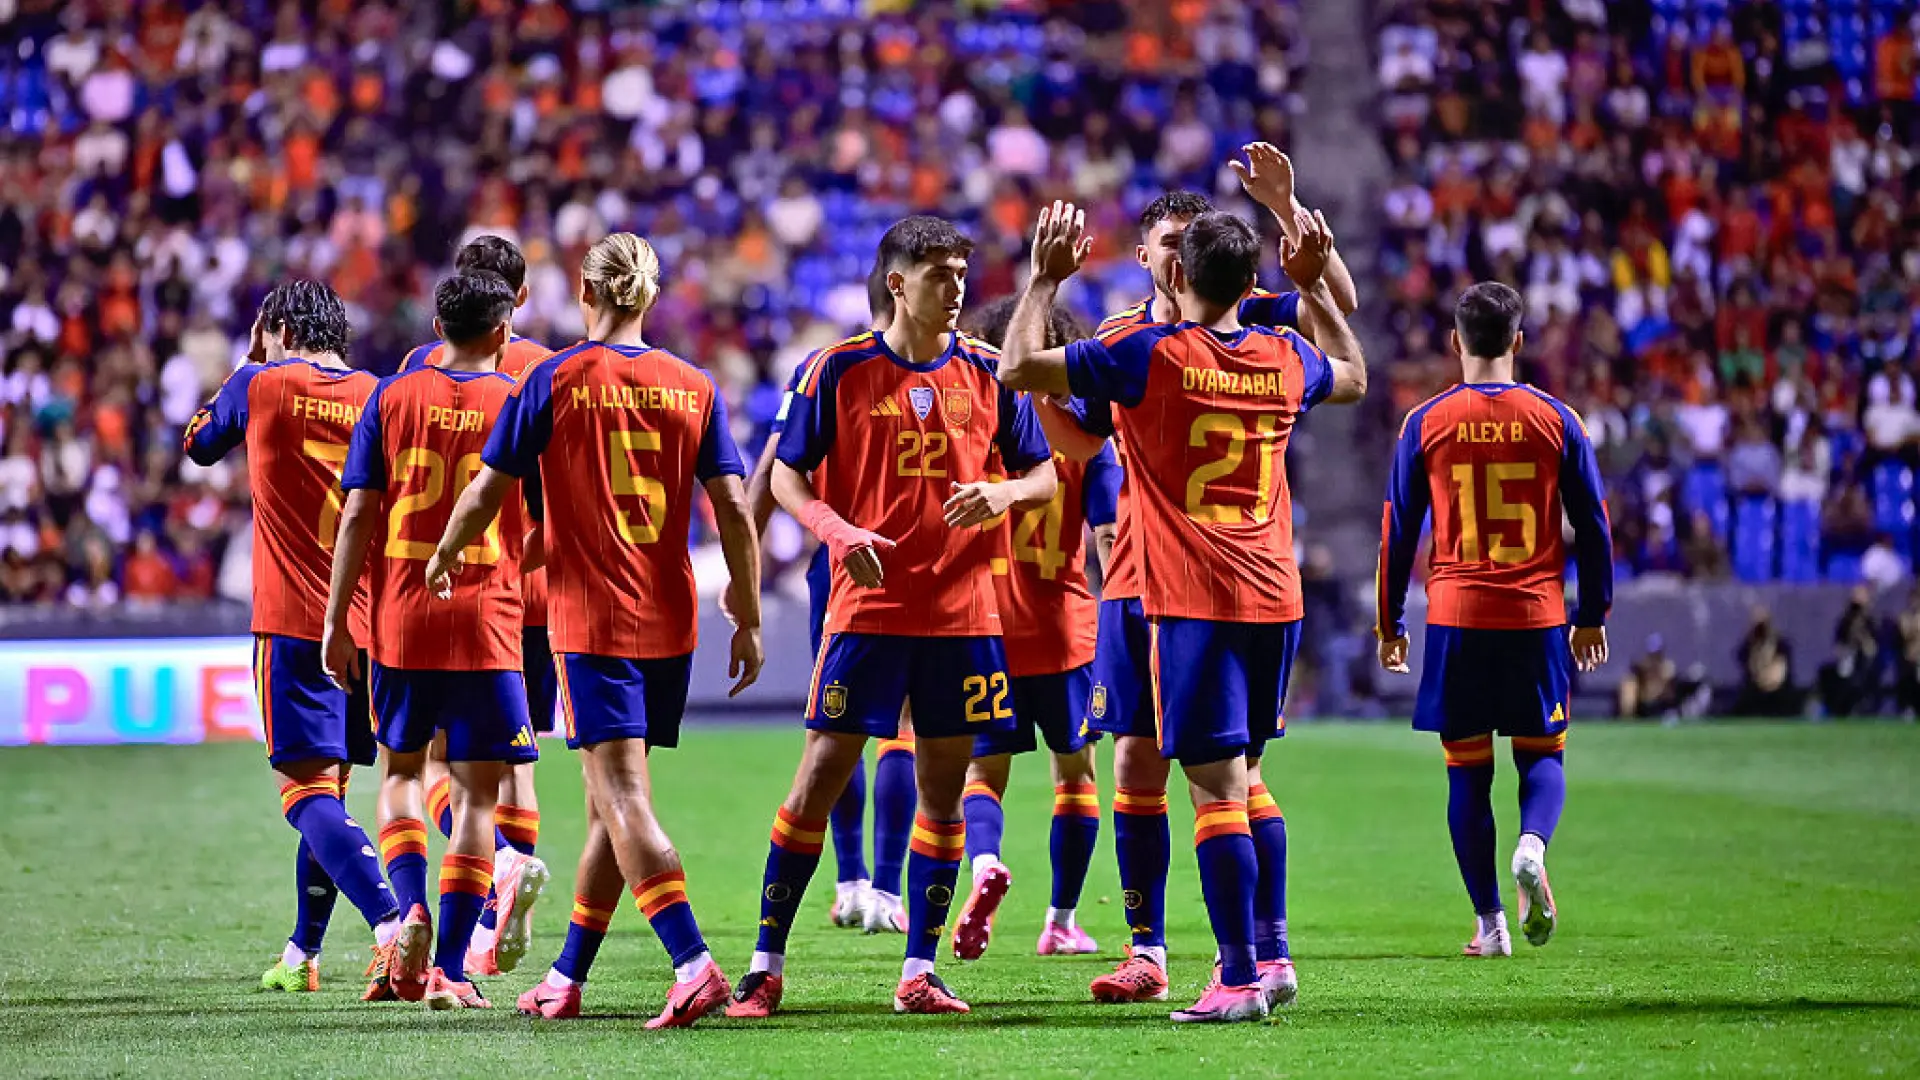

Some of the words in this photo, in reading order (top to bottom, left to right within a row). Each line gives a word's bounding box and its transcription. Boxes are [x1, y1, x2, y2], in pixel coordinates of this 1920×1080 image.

[571, 386, 597, 409] M.
[601, 385, 699, 413] LLORENTE
[1183, 367, 1286, 396] OYARZABAL
[427, 405, 485, 432] PEDRI
[1457, 422, 1504, 443] ALEX
[1510, 422, 1528, 443] B.
[897, 430, 948, 478] 22
[1186, 413, 1277, 524] 21
[610, 431, 667, 543] 5
[1452, 462, 1537, 563] 15
[25, 666, 254, 743] PUE
[963, 671, 1013, 722] 22
